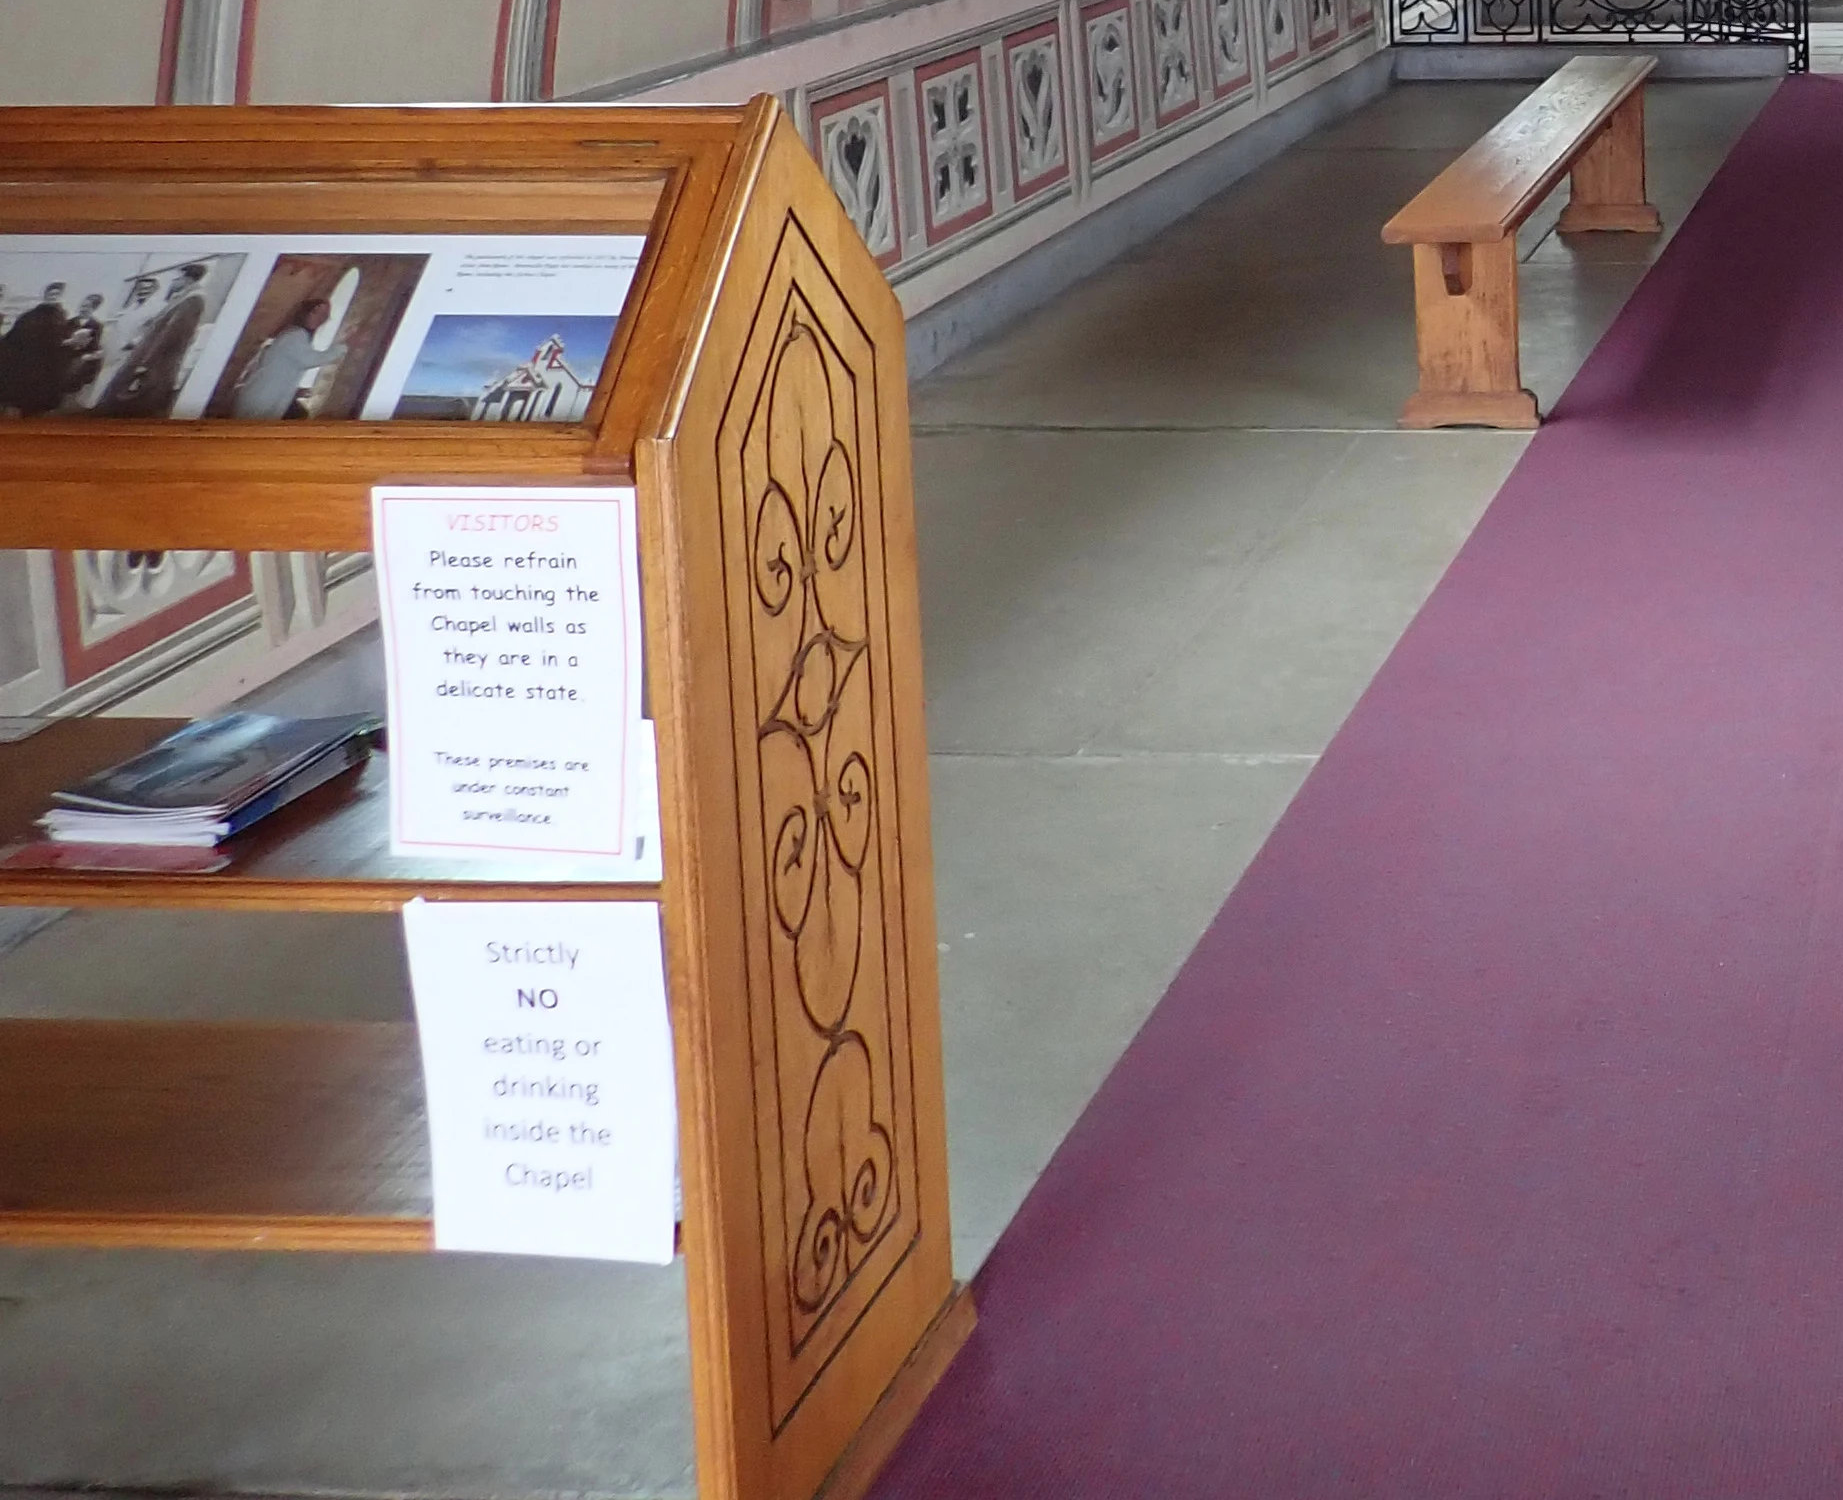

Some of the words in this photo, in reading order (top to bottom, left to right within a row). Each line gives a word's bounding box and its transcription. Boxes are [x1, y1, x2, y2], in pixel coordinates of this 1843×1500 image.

[448, 515, 559, 532] VISITORS
[430, 551, 492, 568] Please
[504, 552, 577, 569] refrain
[413, 583, 460, 599] from
[472, 586, 555, 605] touching
[567, 587, 599, 602] the
[431, 615, 496, 636] Chapel
[508, 617, 555, 634] walls
[566, 622, 586, 635] as
[444, 651, 487, 668] they
[499, 654, 530, 666] are
[542, 653, 558, 666] in
[569, 655, 578, 667] a
[437, 682, 515, 699] delicate
[435, 752, 479, 767] These
[489, 758, 556, 775] premises
[565, 760, 589, 772] are
[452, 781, 495, 794] under
[505, 784, 568, 797] constant
[486, 942, 579, 969] Strictly
[518, 988, 558, 1009] NO
[484, 1036, 565, 1061] eating
[575, 1039, 601, 1056] or
[493, 1076, 599, 1105] drinking
[486, 1118, 560, 1143] inside
[571, 1121, 611, 1146] the
[506, 1163, 593, 1192] Chapel
